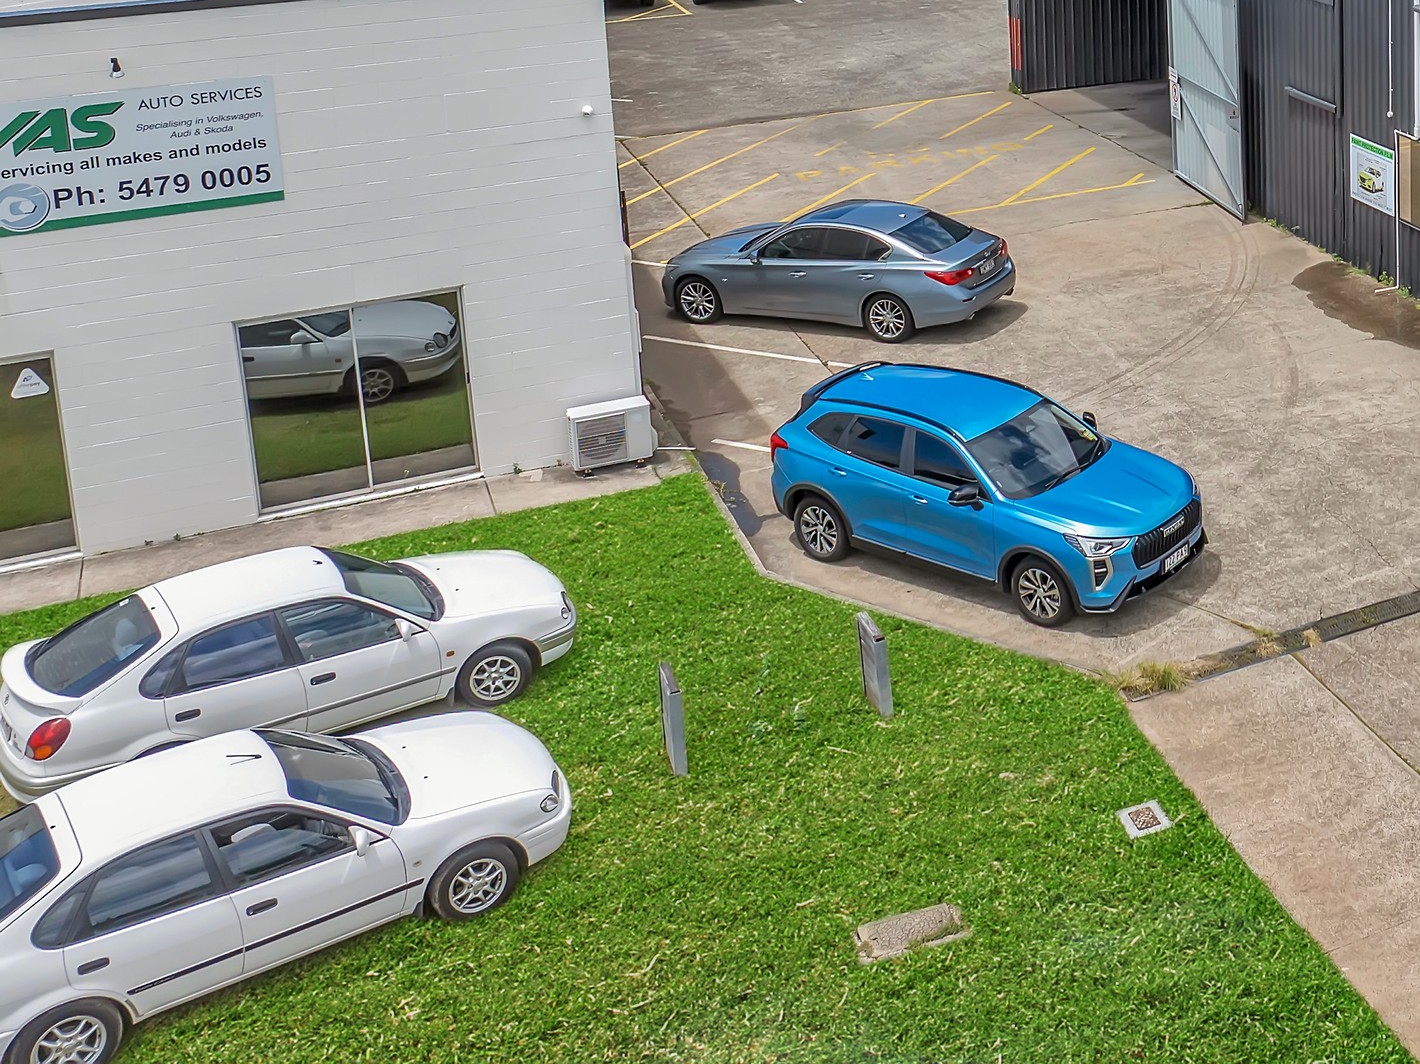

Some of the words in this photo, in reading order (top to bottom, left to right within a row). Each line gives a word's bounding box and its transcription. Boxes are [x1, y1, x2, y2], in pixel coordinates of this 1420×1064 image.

[138, 95, 184, 111] AUTO
[191, 86, 263, 105] SERVICES
[136, 118, 192, 132] Specialising
[195, 117, 204, 125] in
[206, 111, 264, 123] Volkswagen,
[170, 129, 192, 139] Audi
[194, 128, 201, 136] &
[204, 125, 233, 135] Skoda
[0, 161, 74, 179] ervicing
[80, 156, 100, 170] all
[106, 151, 163, 167] makes
[168, 144, 200, 159] and
[205, 137, 267, 155] models
[53, 185, 106, 209] Ph:
[118, 173, 191, 201] 5479
[201, 163, 272, 190] 0005
